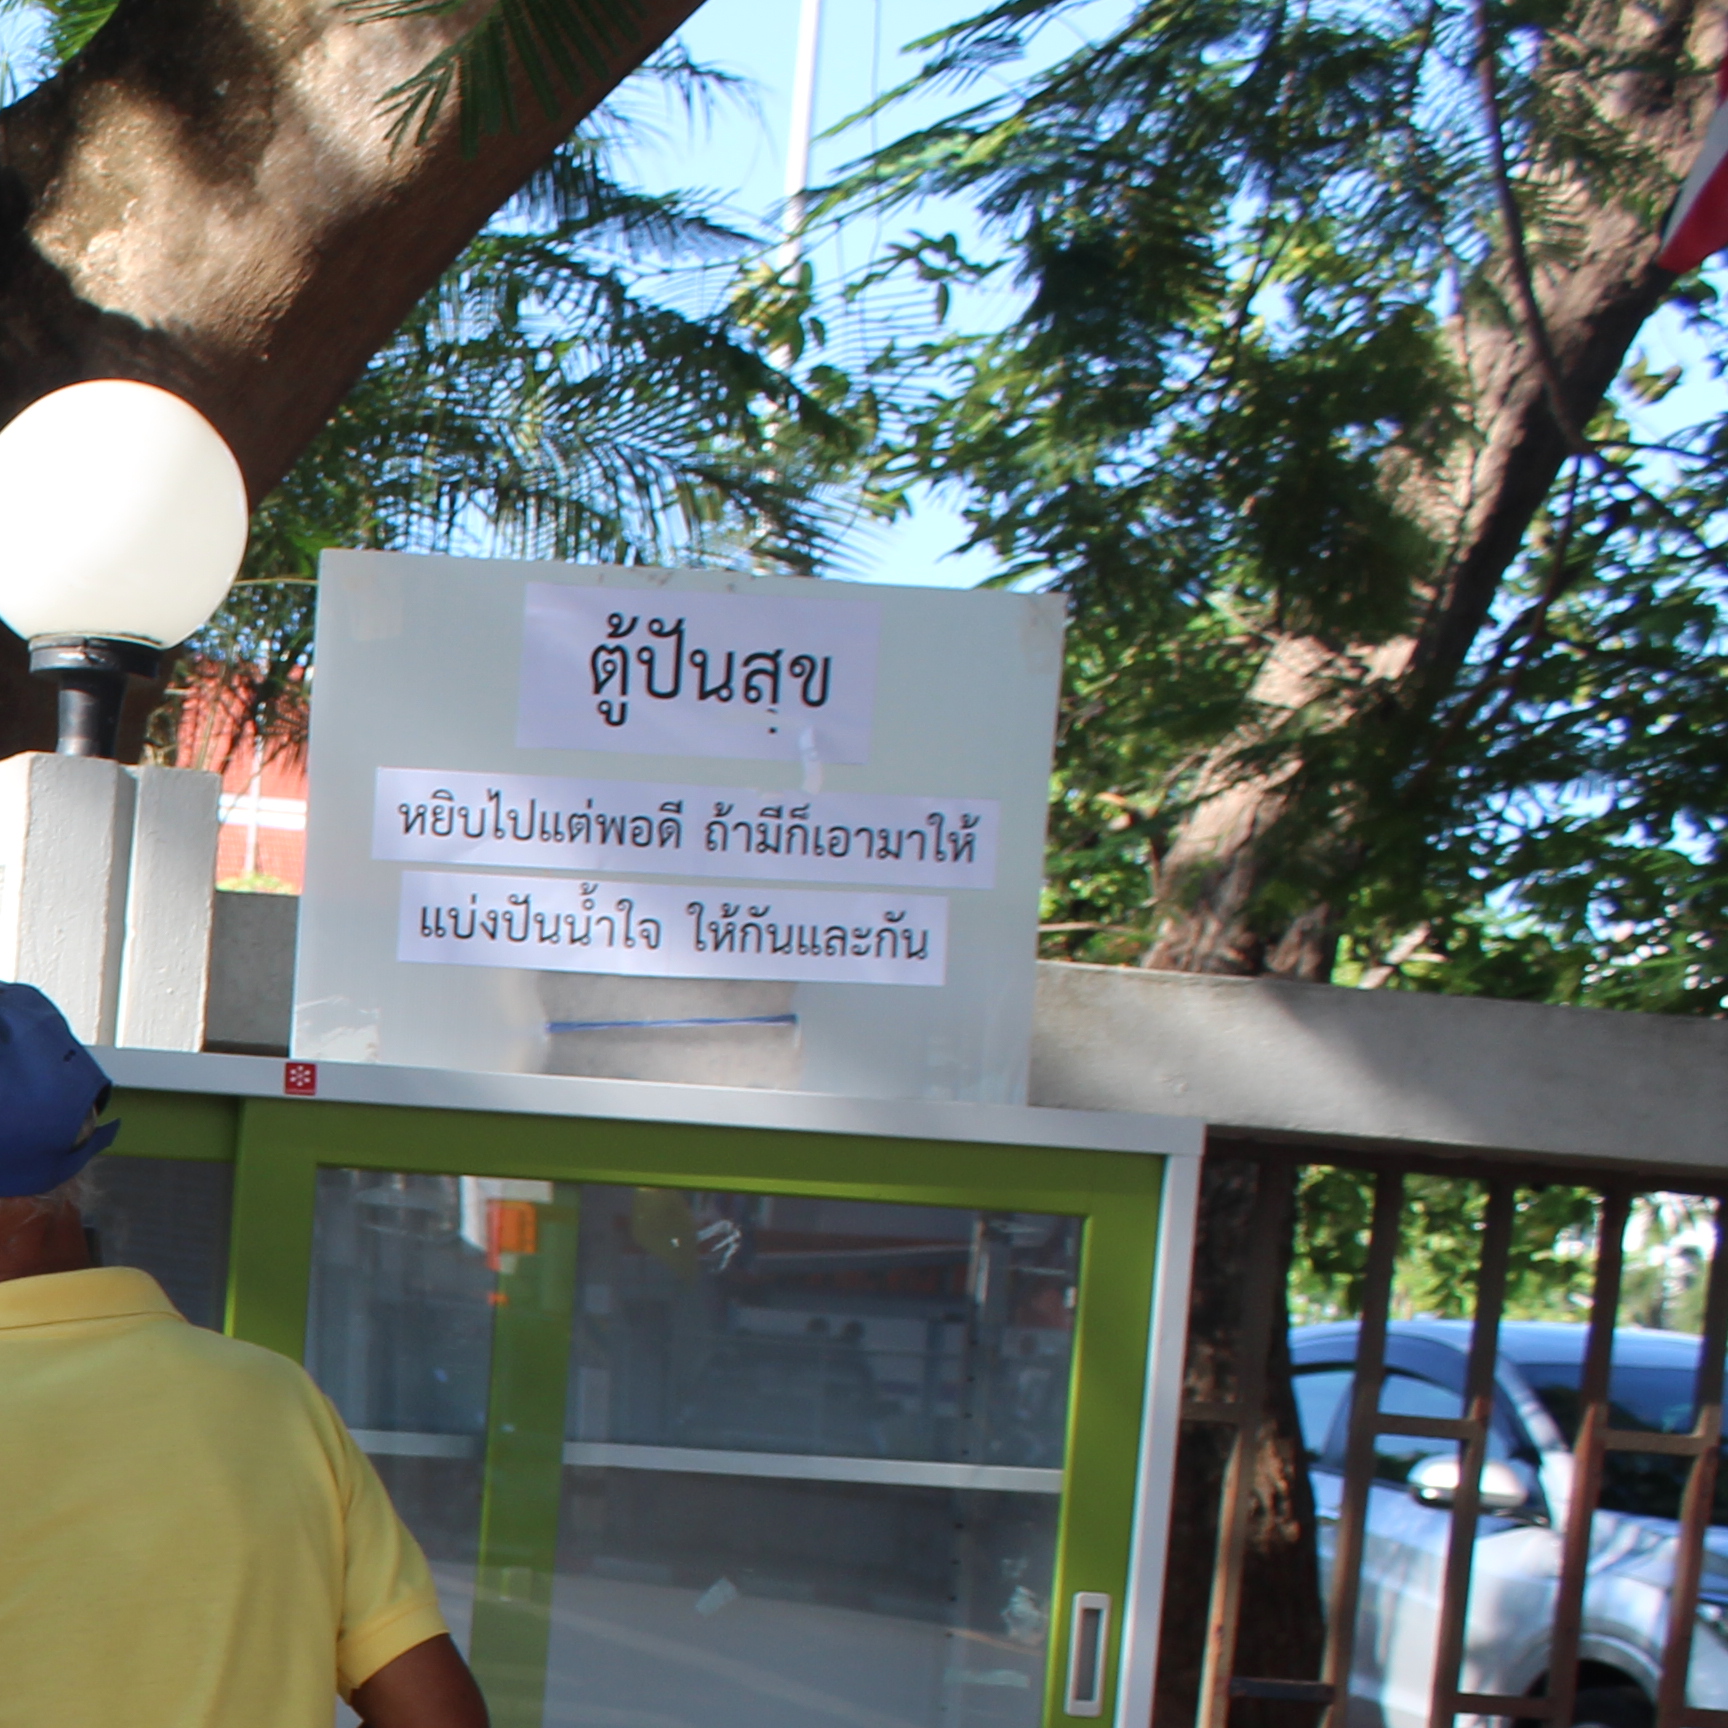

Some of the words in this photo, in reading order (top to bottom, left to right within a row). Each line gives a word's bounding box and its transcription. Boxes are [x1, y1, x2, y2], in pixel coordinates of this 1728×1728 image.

[589, 611, 834, 734] ตู้ปันสุข
[397, 788, 684, 852] หยิบไปแต่พอดี
[704, 803, 978, 866] ถ้ามีก็เอามาให้
[419, 881, 663, 952] แบ่งปันน้ำใจ
[688, 900, 930, 962] ให้กันและกัน
